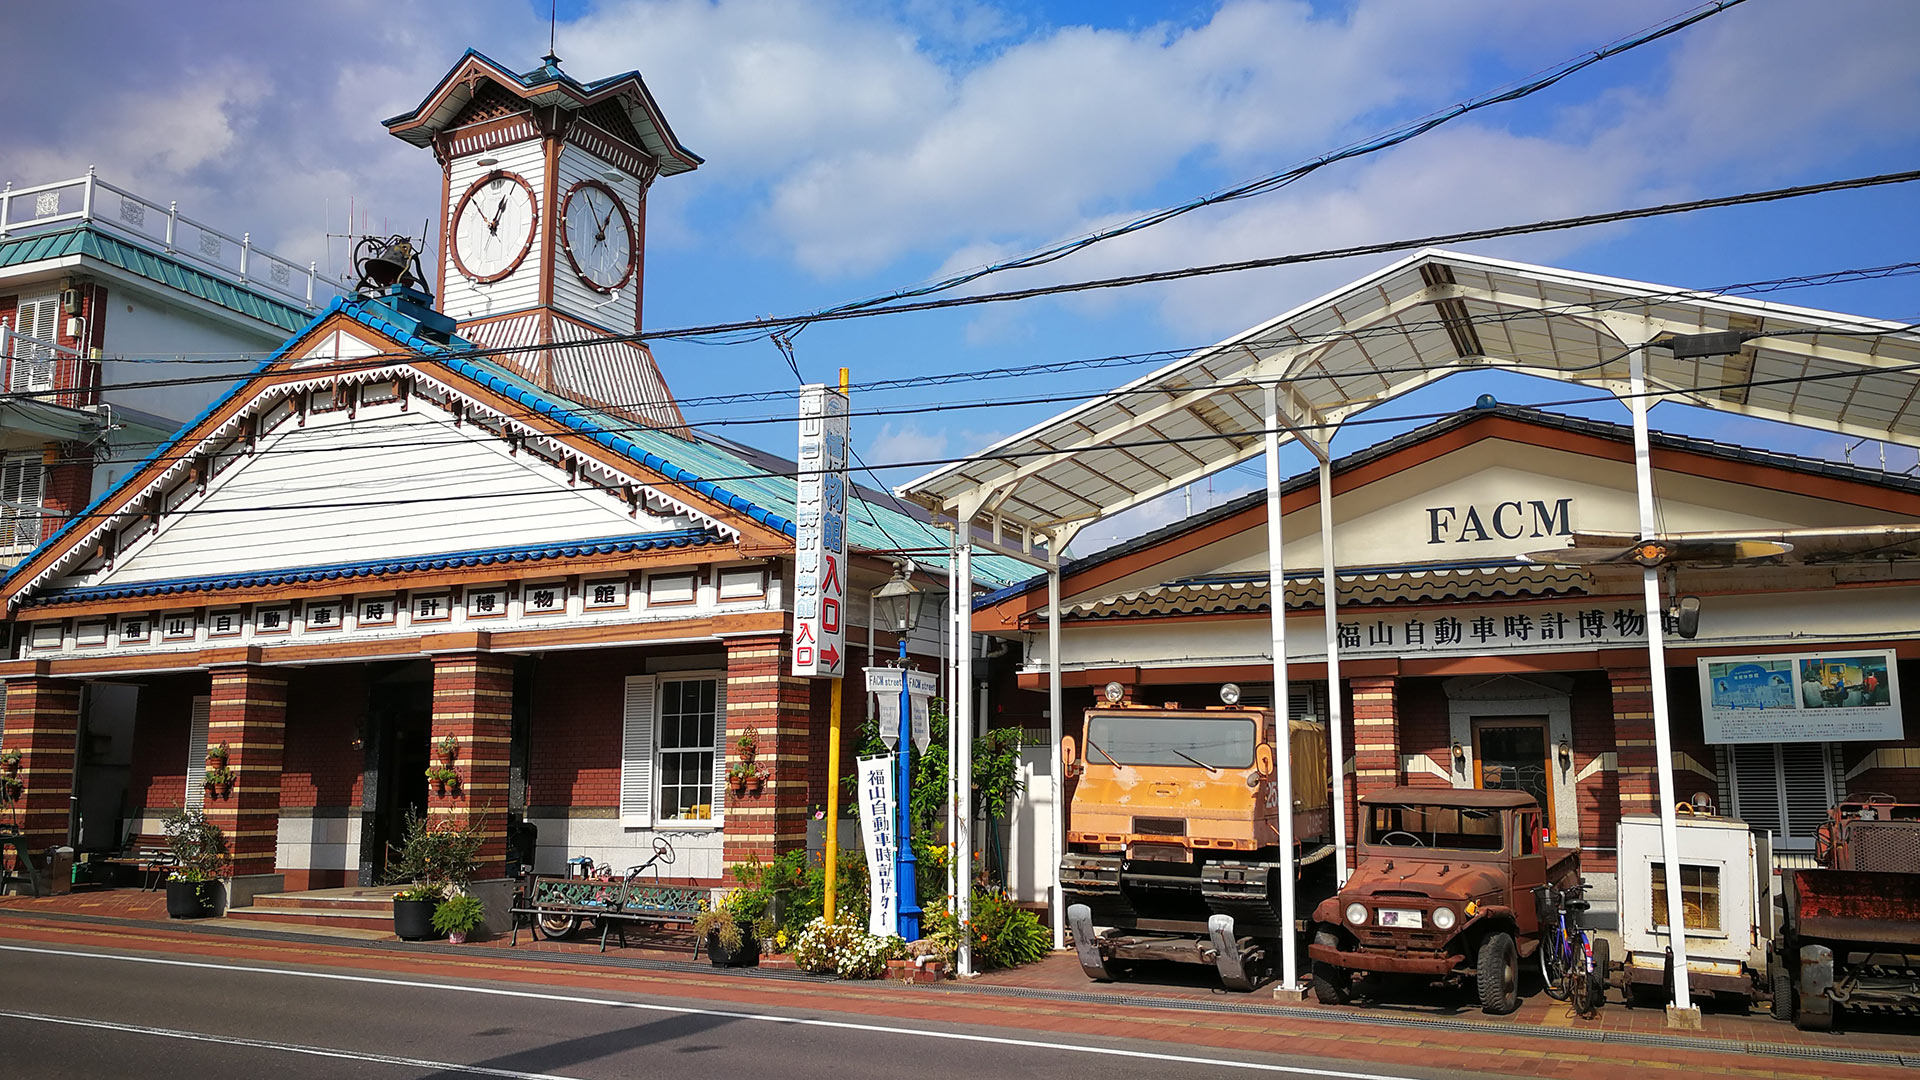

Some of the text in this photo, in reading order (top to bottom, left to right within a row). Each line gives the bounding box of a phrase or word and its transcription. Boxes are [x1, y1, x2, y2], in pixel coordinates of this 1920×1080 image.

[1426, 498, 1573, 545] FACM
[126, 585, 616, 638] 福山自動車時計博物館
[869, 675, 902, 687] FACM street
[908, 677, 921, 689] FACM
